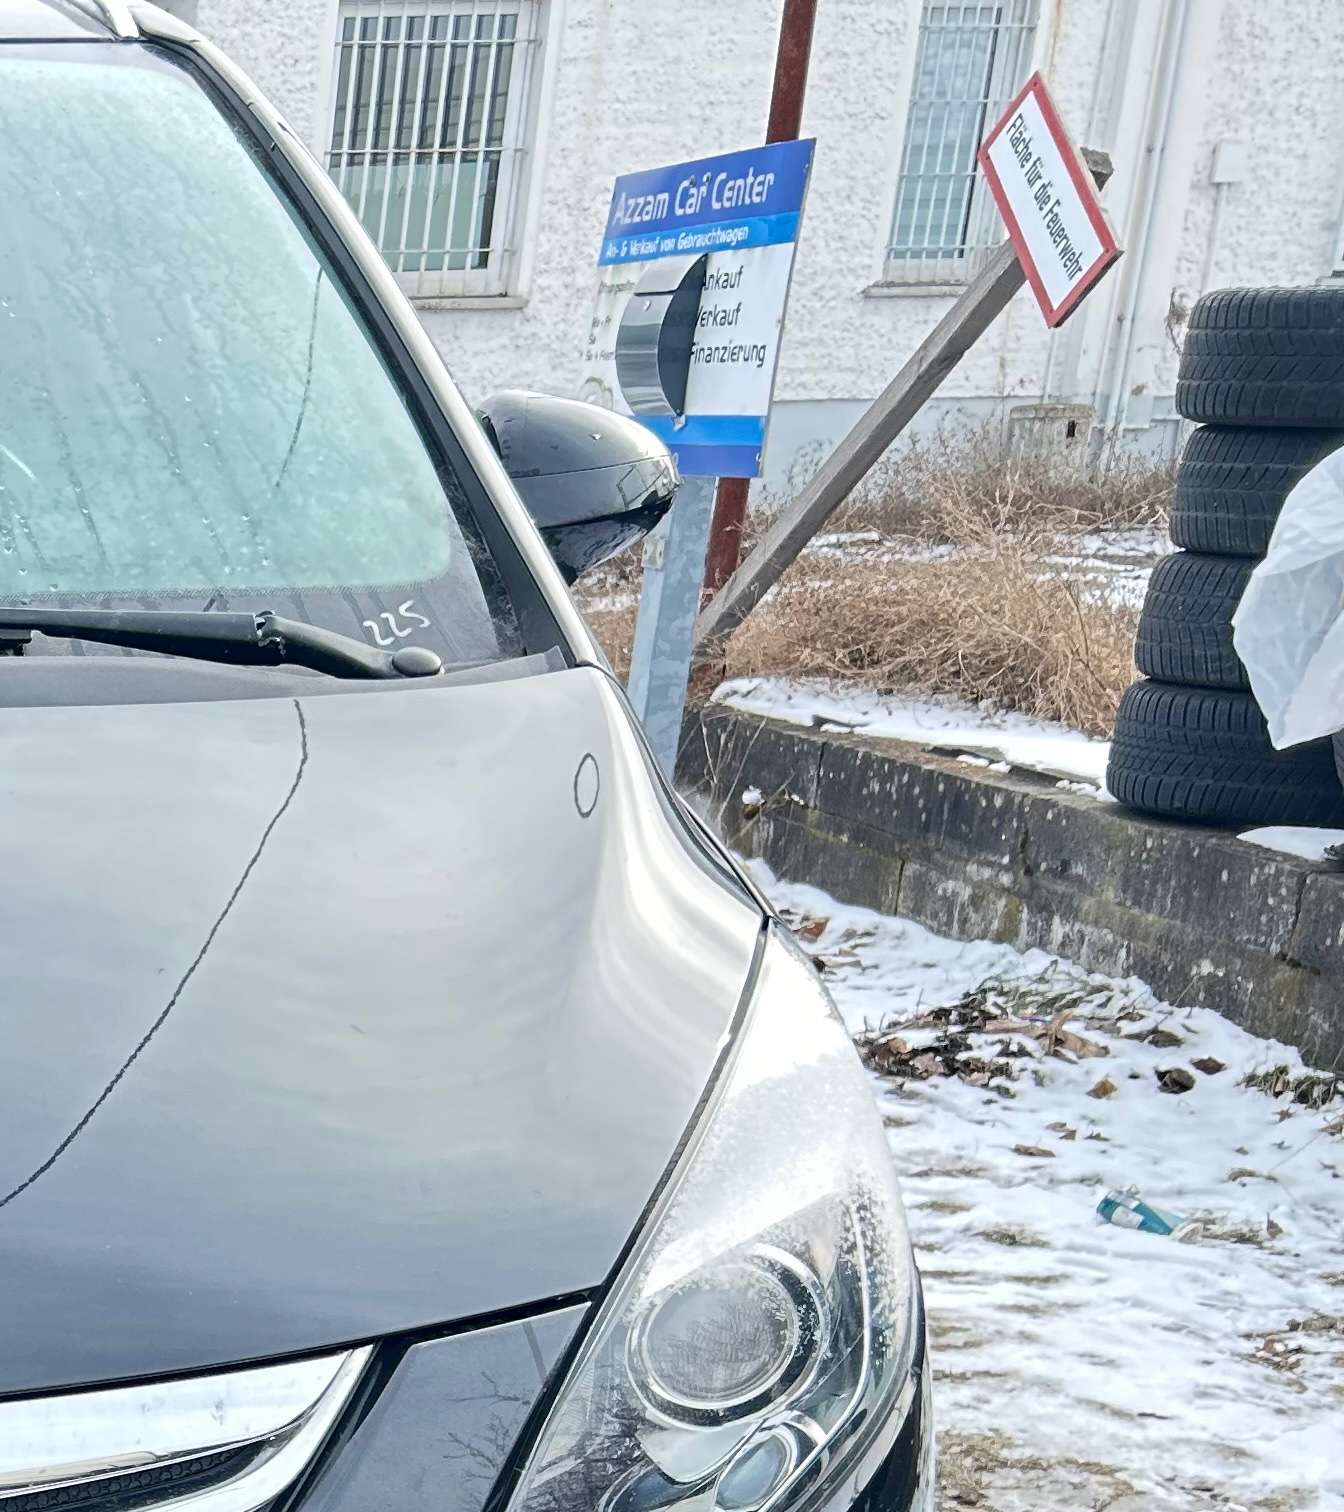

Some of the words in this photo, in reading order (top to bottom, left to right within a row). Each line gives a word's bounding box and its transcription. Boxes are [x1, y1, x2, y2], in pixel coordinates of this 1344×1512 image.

[1006, 113, 1032, 168] Fläche
[1024, 156, 1043, 190] für
[612, 191, 669, 225] Azzam
[675, 178, 707, 216] Car
[712, 166, 775, 210] Center
[1034, 178, 1053, 211] die
[660, 237, 676, 253] von
[677, 226, 749, 250] Gebrauchtwagen
[1043, 199, 1084, 281] Feuerwehr
[691, 339, 767, 368] Finanzierung
